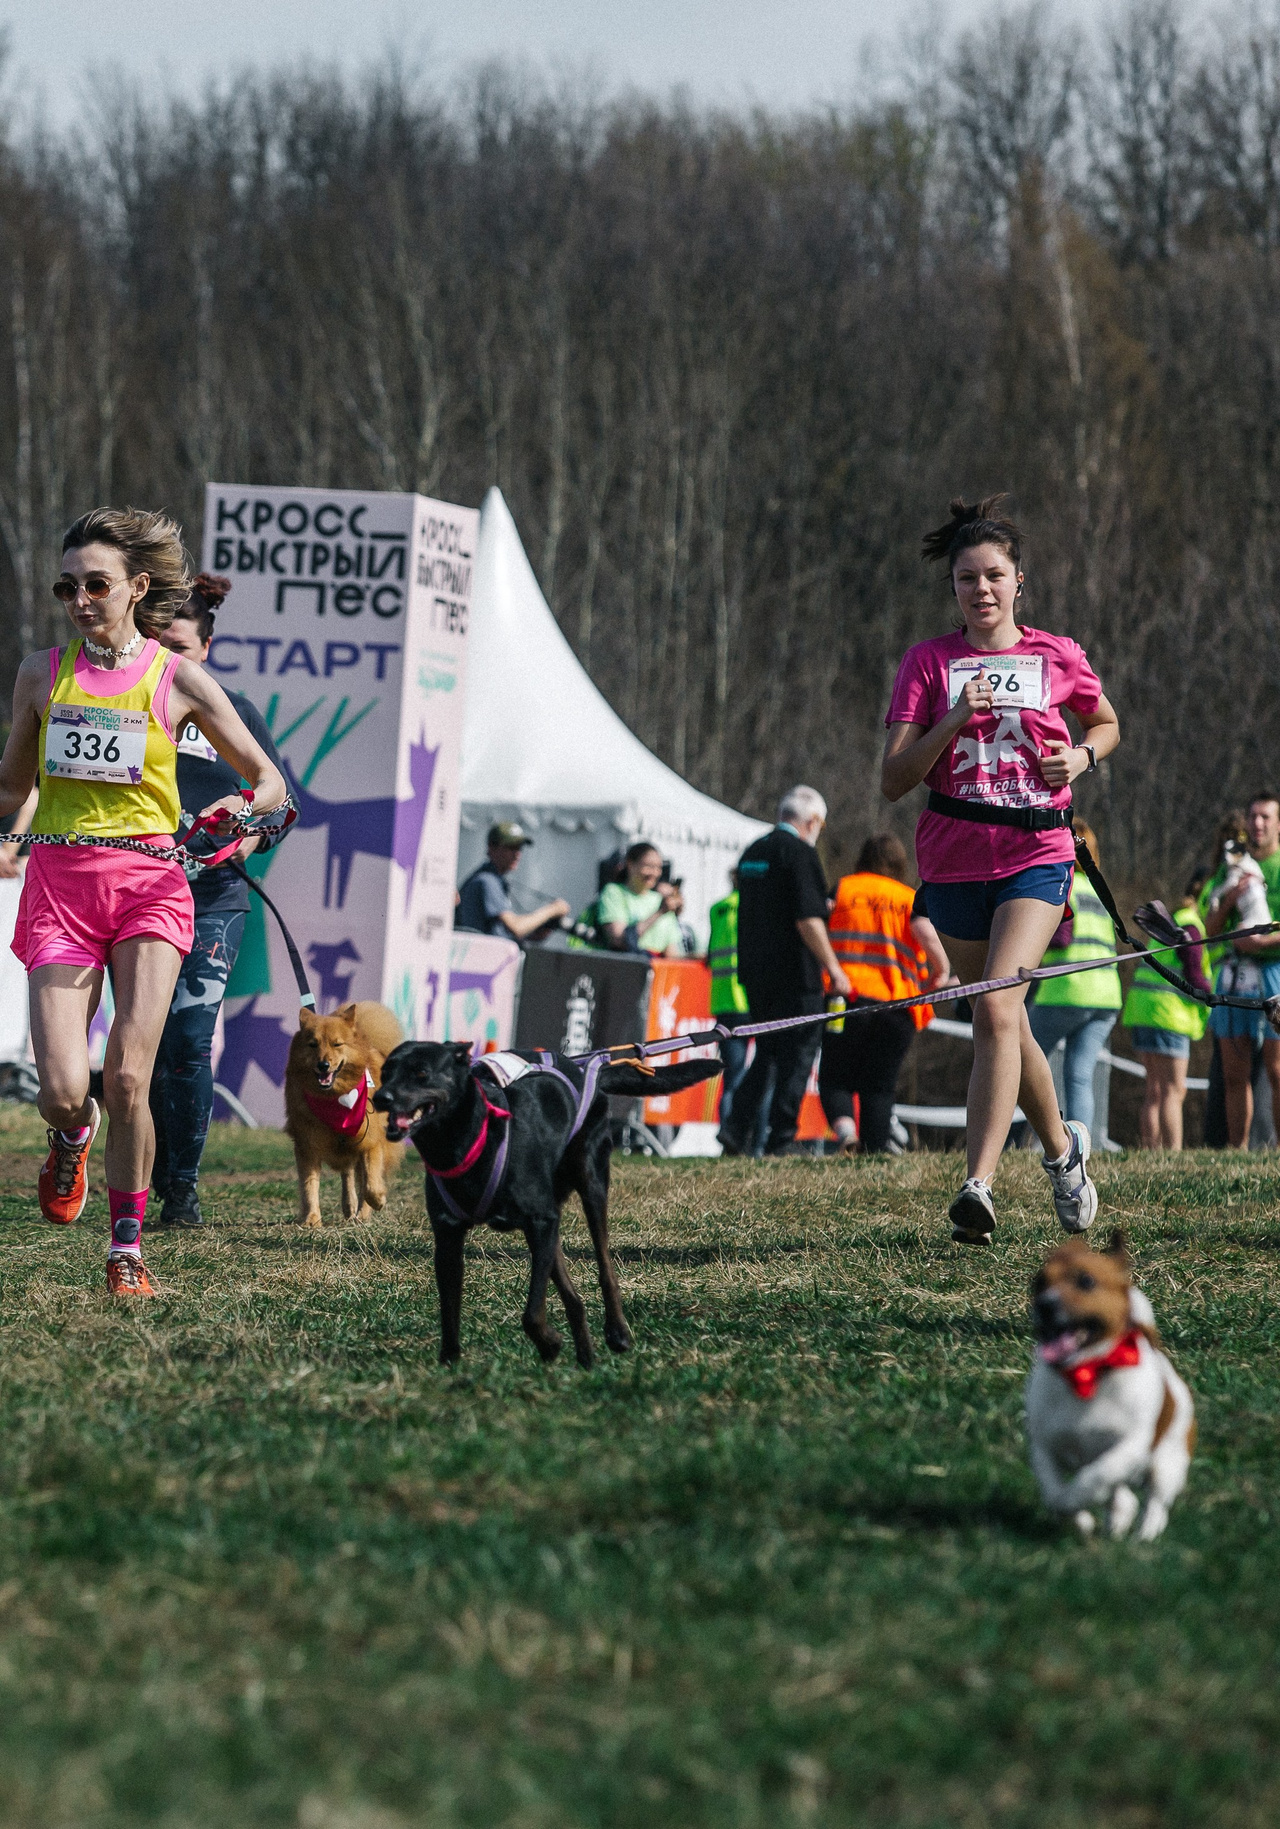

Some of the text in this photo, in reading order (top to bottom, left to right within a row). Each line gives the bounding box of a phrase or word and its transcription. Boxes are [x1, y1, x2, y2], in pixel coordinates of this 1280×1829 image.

[208, 635, 402, 681] СТАРТ
[971, 673, 1020, 692] 96
[64, 731, 121, 763] 336
[959, 779, 1036, 795] #МОЯ СОБАКА
